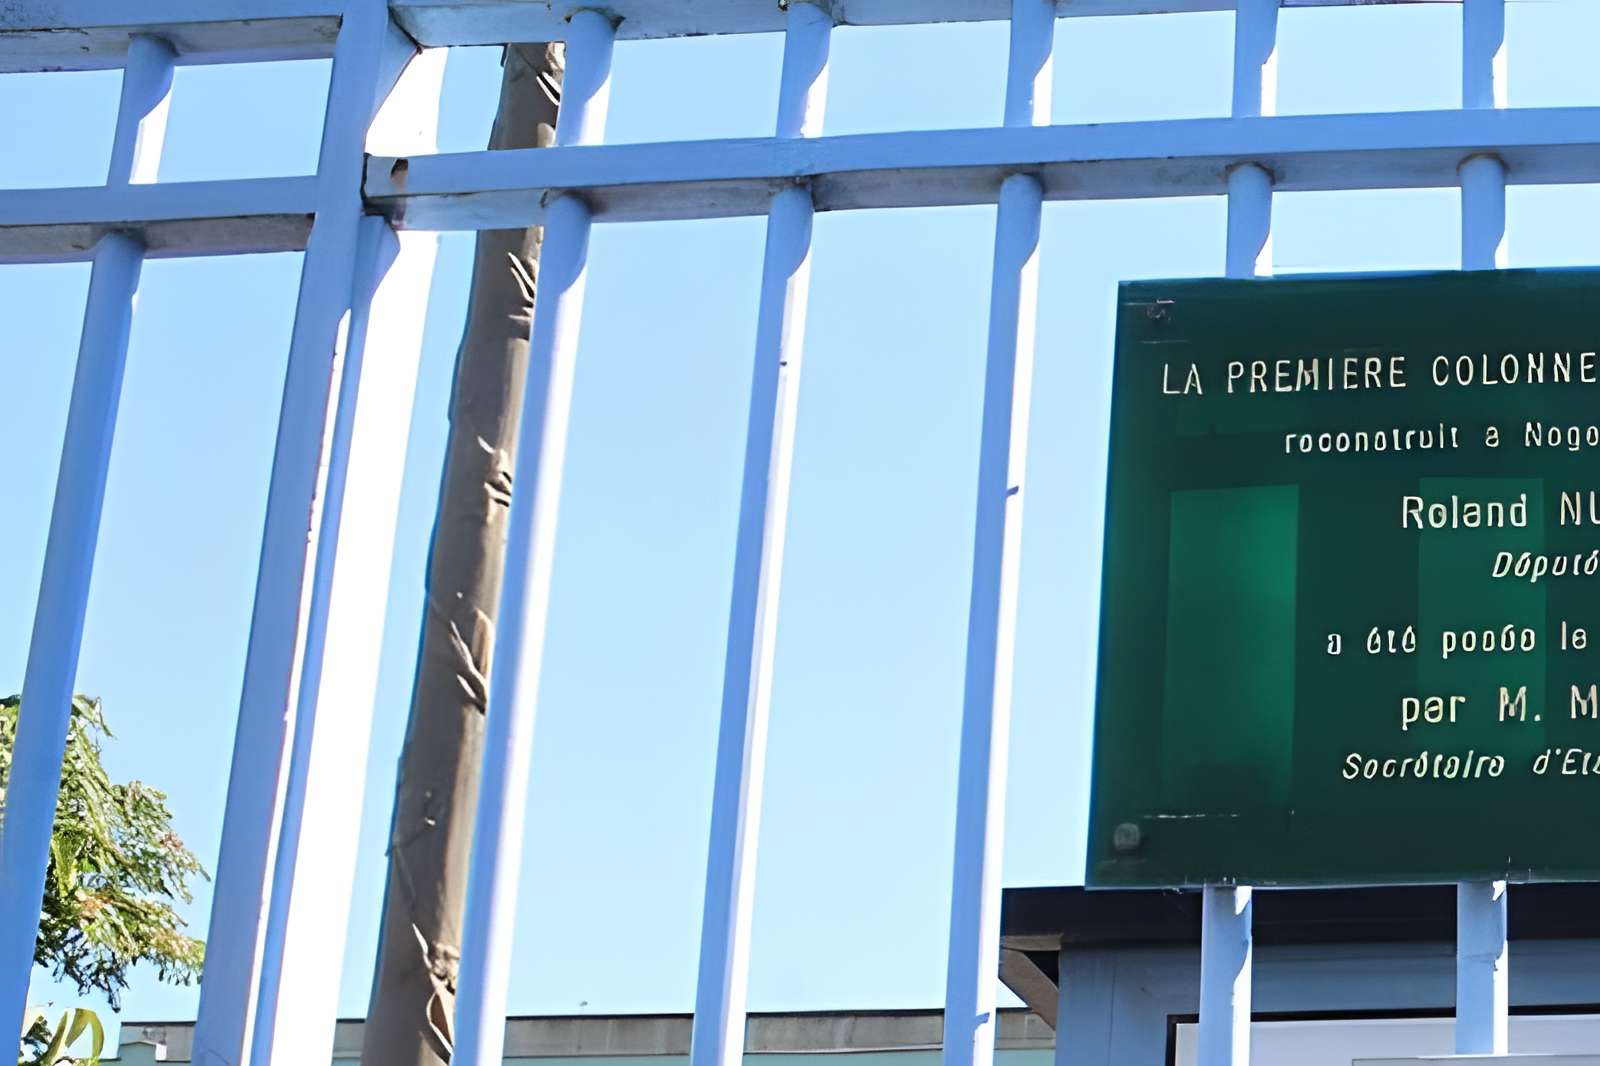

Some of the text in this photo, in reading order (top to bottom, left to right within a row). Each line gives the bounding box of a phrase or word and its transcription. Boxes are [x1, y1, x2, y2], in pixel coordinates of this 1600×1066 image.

[1162, 362, 1203, 396] LA
[1227, 356, 1407, 394] PREMIERE
[1432, 351, 1597, 387] COLONNE
[1402, 493, 1528, 530] Roland
[1561, 620, 1587, 651] le
[1401, 695, 1466, 732] par
[1498, 685, 1542, 722] M.
